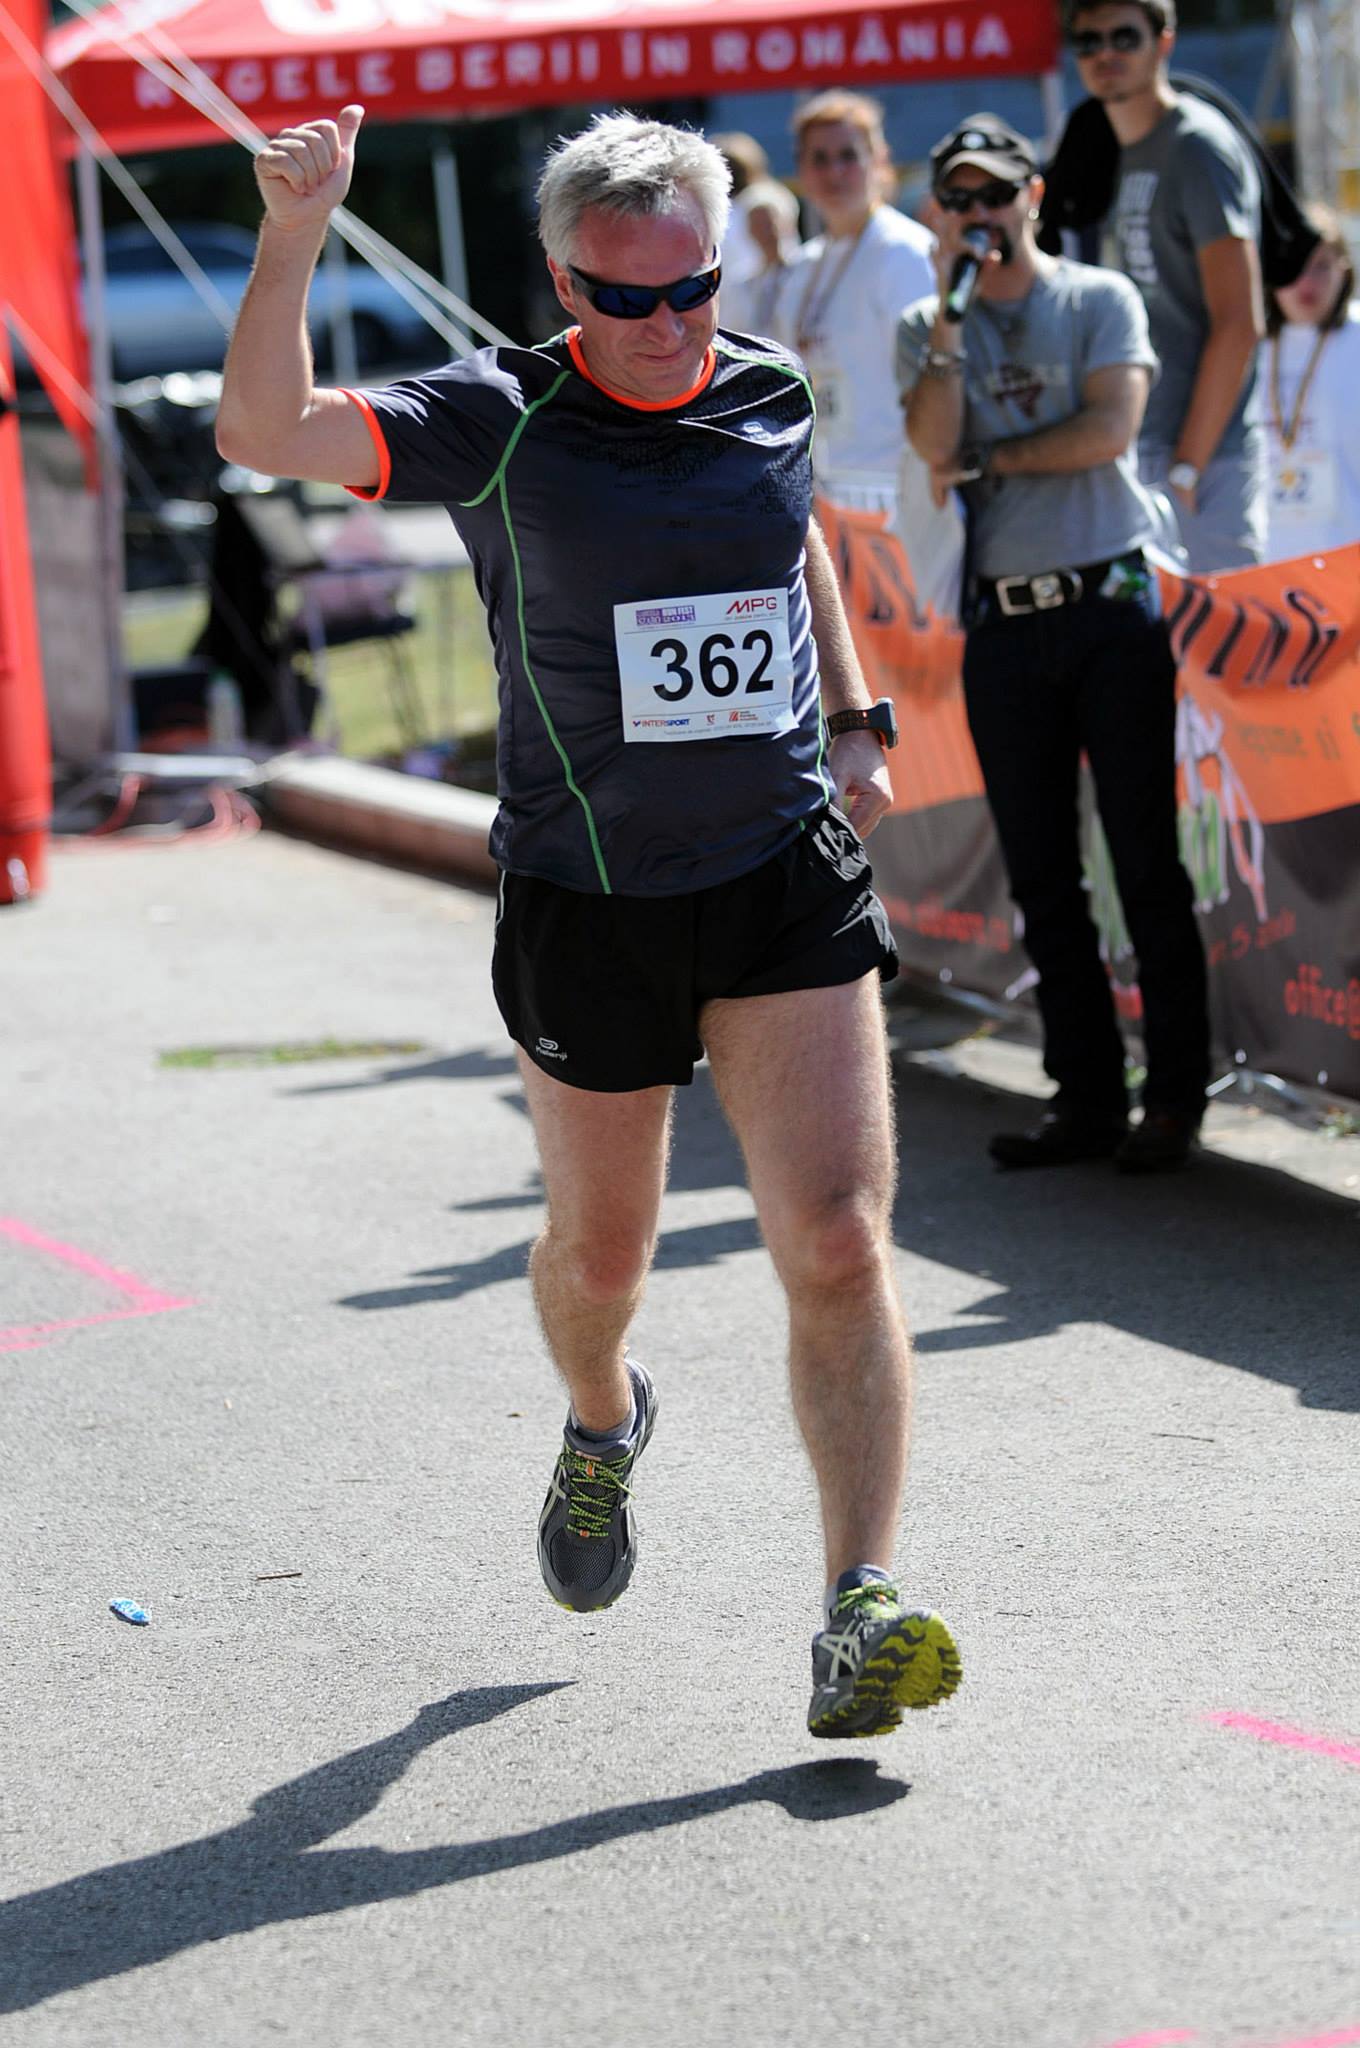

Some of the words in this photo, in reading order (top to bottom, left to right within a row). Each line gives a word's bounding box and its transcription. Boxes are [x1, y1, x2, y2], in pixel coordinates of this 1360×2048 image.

[134, 55, 394, 108] RGELE
[417, 36, 600, 92] BERII
[712, 13, 1011, 74] ROMÂNIA
[726, 596, 777, 615] MPG
[650, 629, 774, 702] 362
[641, 718, 690, 728] INTERSPORT
